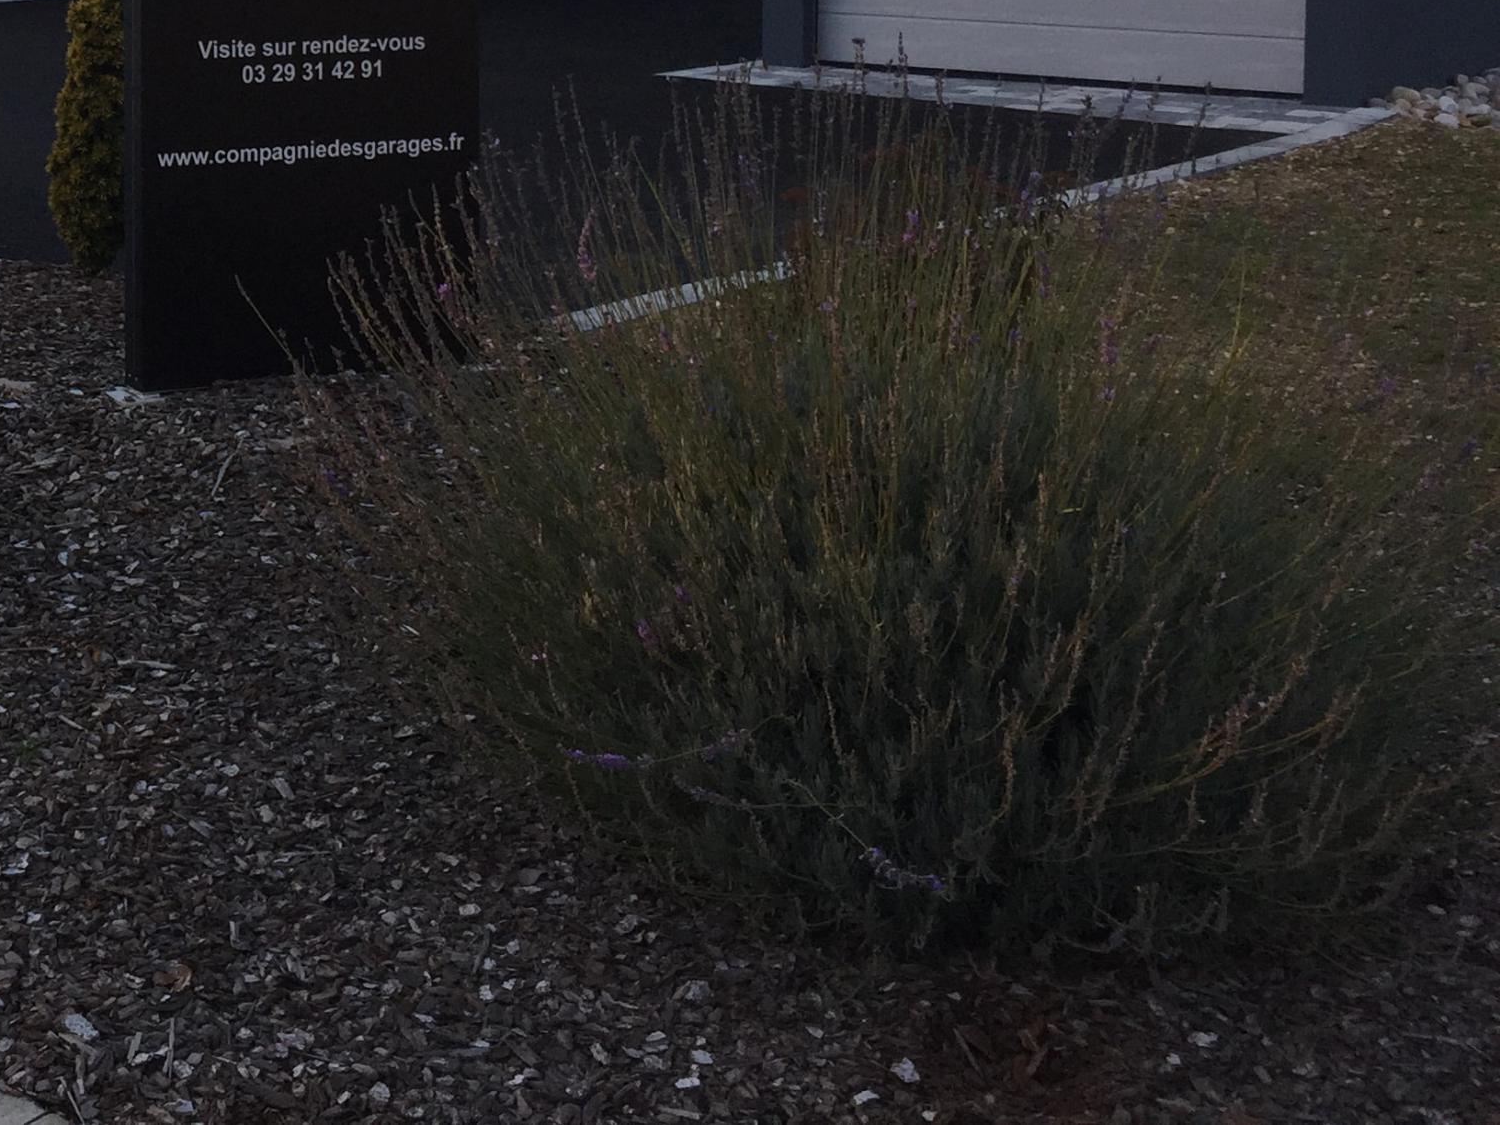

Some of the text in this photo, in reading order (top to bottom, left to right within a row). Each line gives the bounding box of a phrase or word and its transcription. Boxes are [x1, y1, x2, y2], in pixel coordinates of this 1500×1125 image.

[198, 34, 426, 60] Visite sur rendez-vous
[242, 59, 383, 84] 03 29 31 42 91
[157, 132, 465, 167] www.compagniedesgarages.fr
